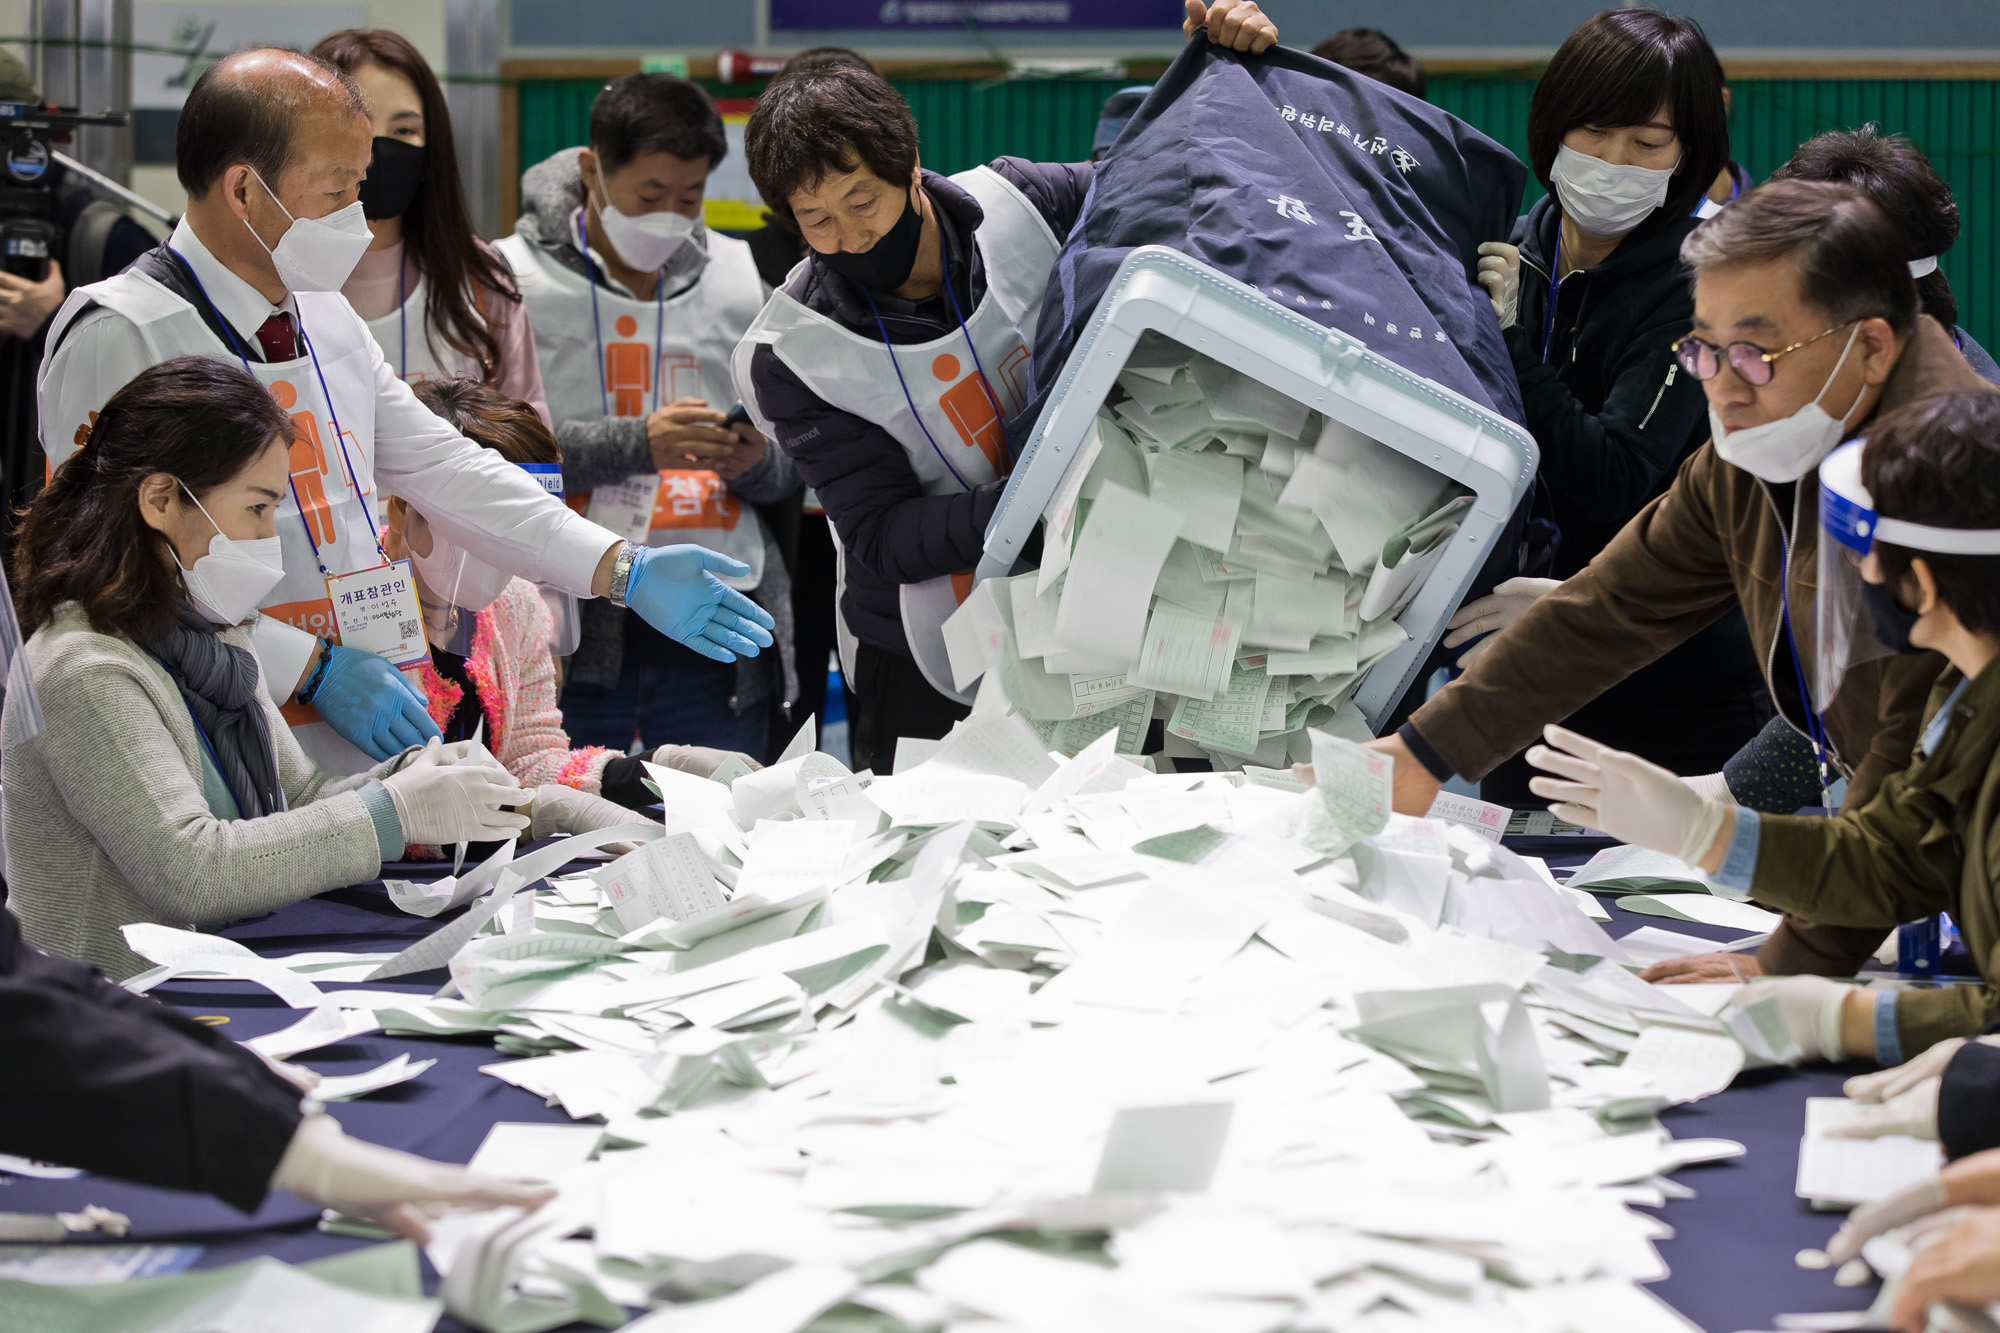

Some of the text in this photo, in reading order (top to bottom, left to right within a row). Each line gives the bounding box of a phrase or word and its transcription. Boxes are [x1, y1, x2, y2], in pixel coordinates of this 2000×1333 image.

[785, 427, 820, 448] Marmot
[536, 477, 560, 490] hield
[340, 579, 406, 605] 개표참관인
